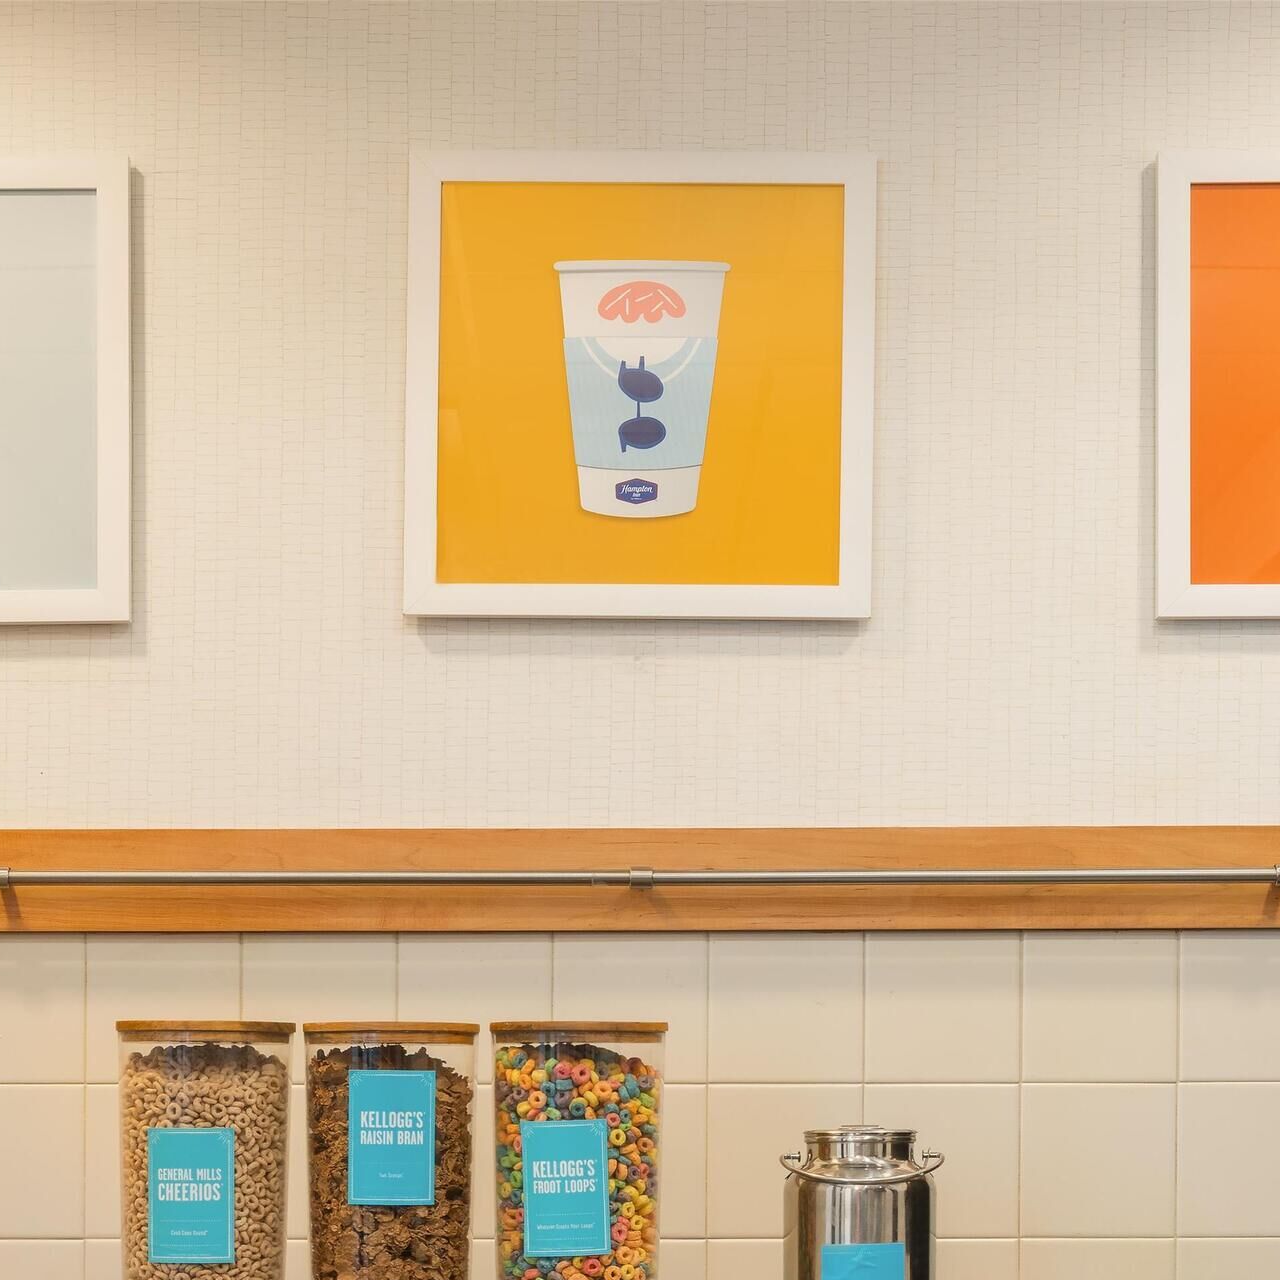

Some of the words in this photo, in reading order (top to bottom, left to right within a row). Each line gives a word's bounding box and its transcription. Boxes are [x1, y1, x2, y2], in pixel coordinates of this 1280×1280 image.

[620, 484, 653, 494] Hampton
[360, 1111, 424, 1128] KELLOGG'S
[360, 1130, 394, 1145] RAISIN
[397, 1130, 424, 1145] BRAN
[158, 1168, 194, 1181] GENERAL
[196, 1168, 222, 1181] MILLS
[532, 1160, 596, 1178] KELLOGG'S
[158, 1183, 221, 1201] CHEERIOS
[533, 1180, 562, 1194] FROOT
[564, 1179, 596, 1193] LOOPS
